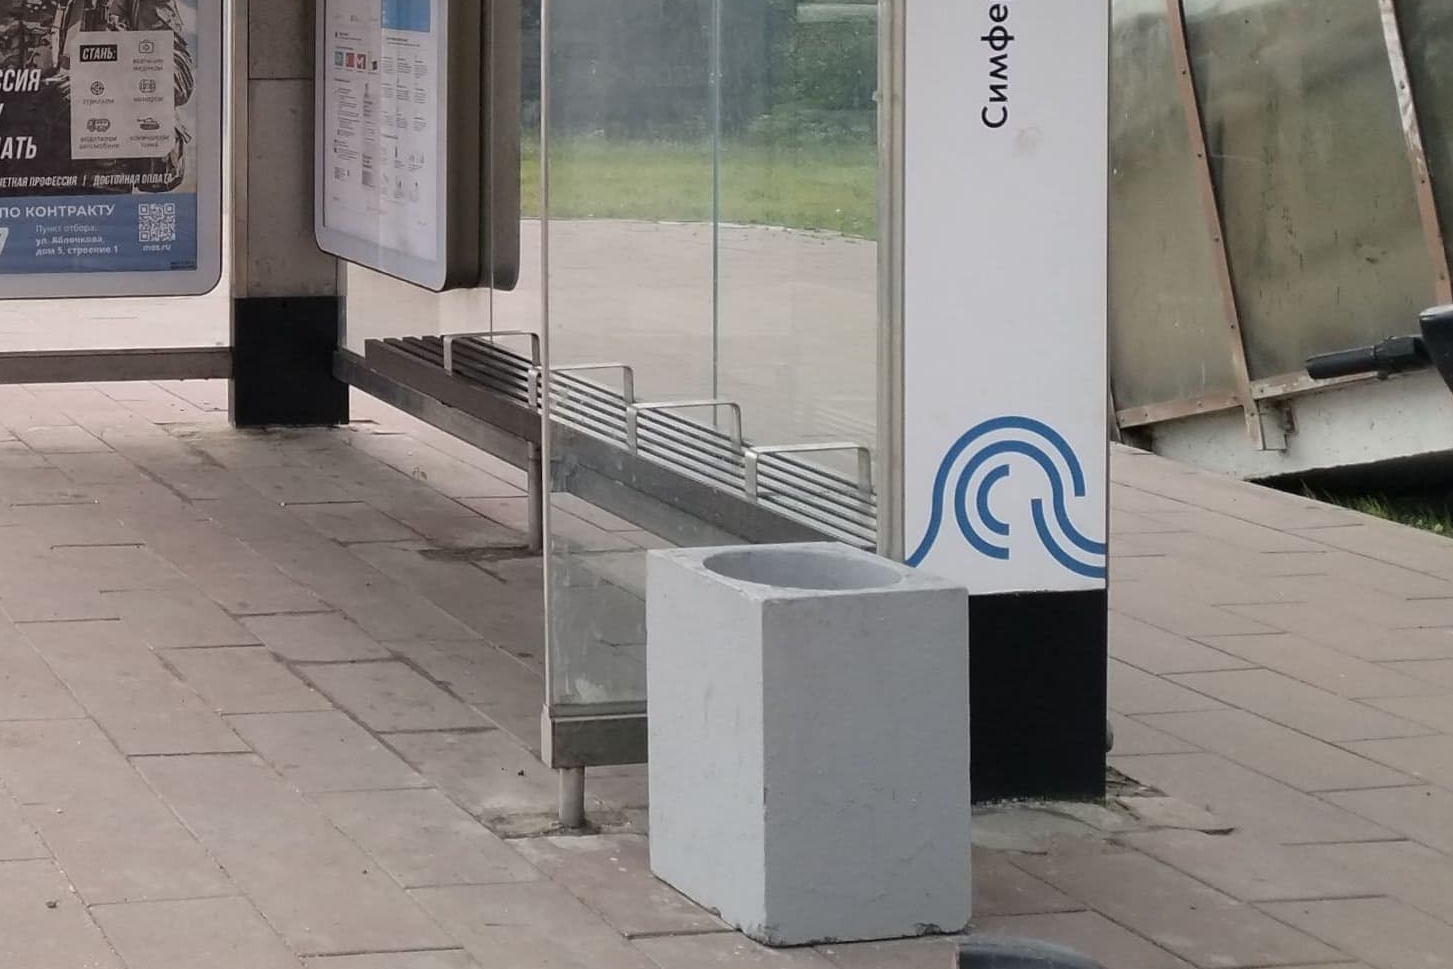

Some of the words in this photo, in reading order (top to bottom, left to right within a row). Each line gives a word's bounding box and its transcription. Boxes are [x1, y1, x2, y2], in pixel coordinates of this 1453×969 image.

[82, 47, 116, 60] СТАНЬ:
[29, 176, 78, 187] ПРОФЕССИЯ
[93, 174, 140, 186] ДОСТОЙНАЯ
[26, 204, 116, 218] КОНТРАКТУ
[36, 225, 62, 234] Пункт
[36, 247, 55, 256] дом
[67, 246, 112, 256] строение
